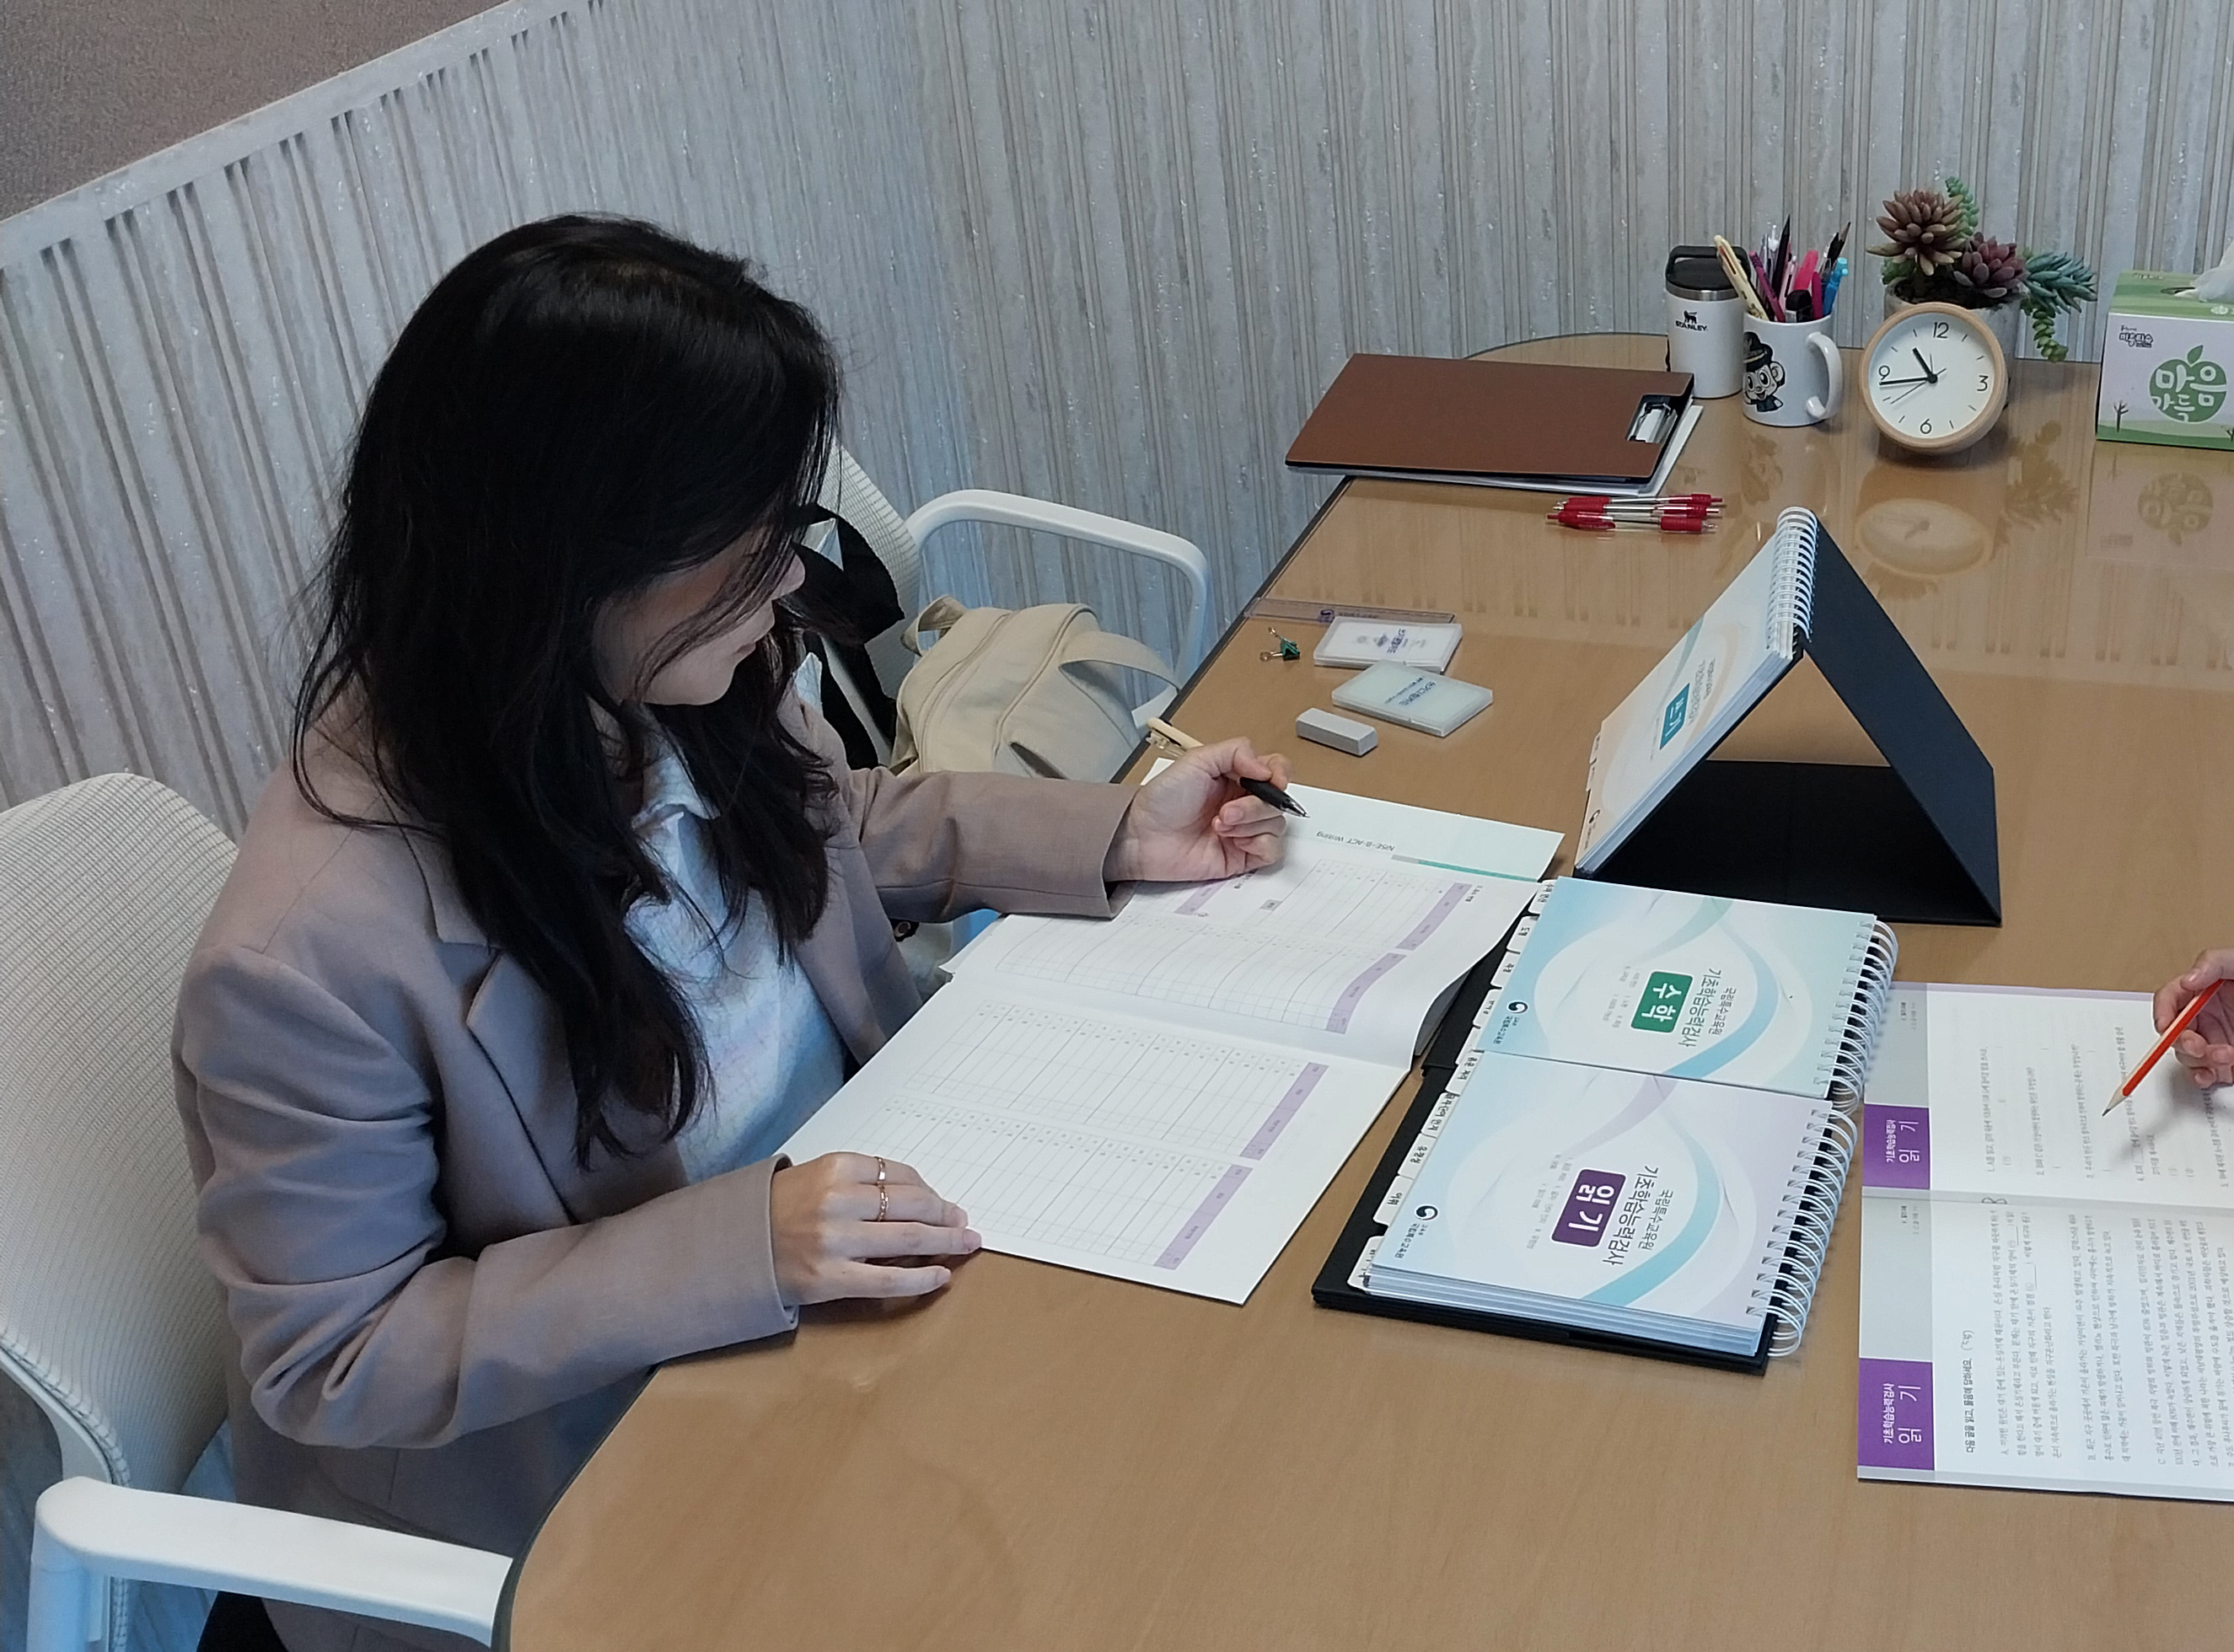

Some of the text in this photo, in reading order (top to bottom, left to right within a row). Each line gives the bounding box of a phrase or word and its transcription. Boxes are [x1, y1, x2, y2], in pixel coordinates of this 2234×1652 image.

[1675, 320, 1707, 331] STANLEY
[1933, 322, 1949, 339] 12
[1878, 365, 1890, 380] 9
[1977, 375, 1989, 391] 3
[2156, 364, 2227, 406] 마음
[1920, 418, 1932, 434] 6
[1678, 968, 1721, 1047] 기초학습능력검사
[1708, 987, 1737, 1035] 국립특수교육원
[1602, 1165, 1658, 1265] 기초학습능력검사
[1638, 1189, 1674, 1251] 국립특수교육원
[1963, 1386, 1974, 1406] 물음에
[1882, 1383, 1895, 1444] 기초학습능력검사
[1964, 1424, 1974, 1437] 글을
[1964, 1440, 1975, 1452] 다음
